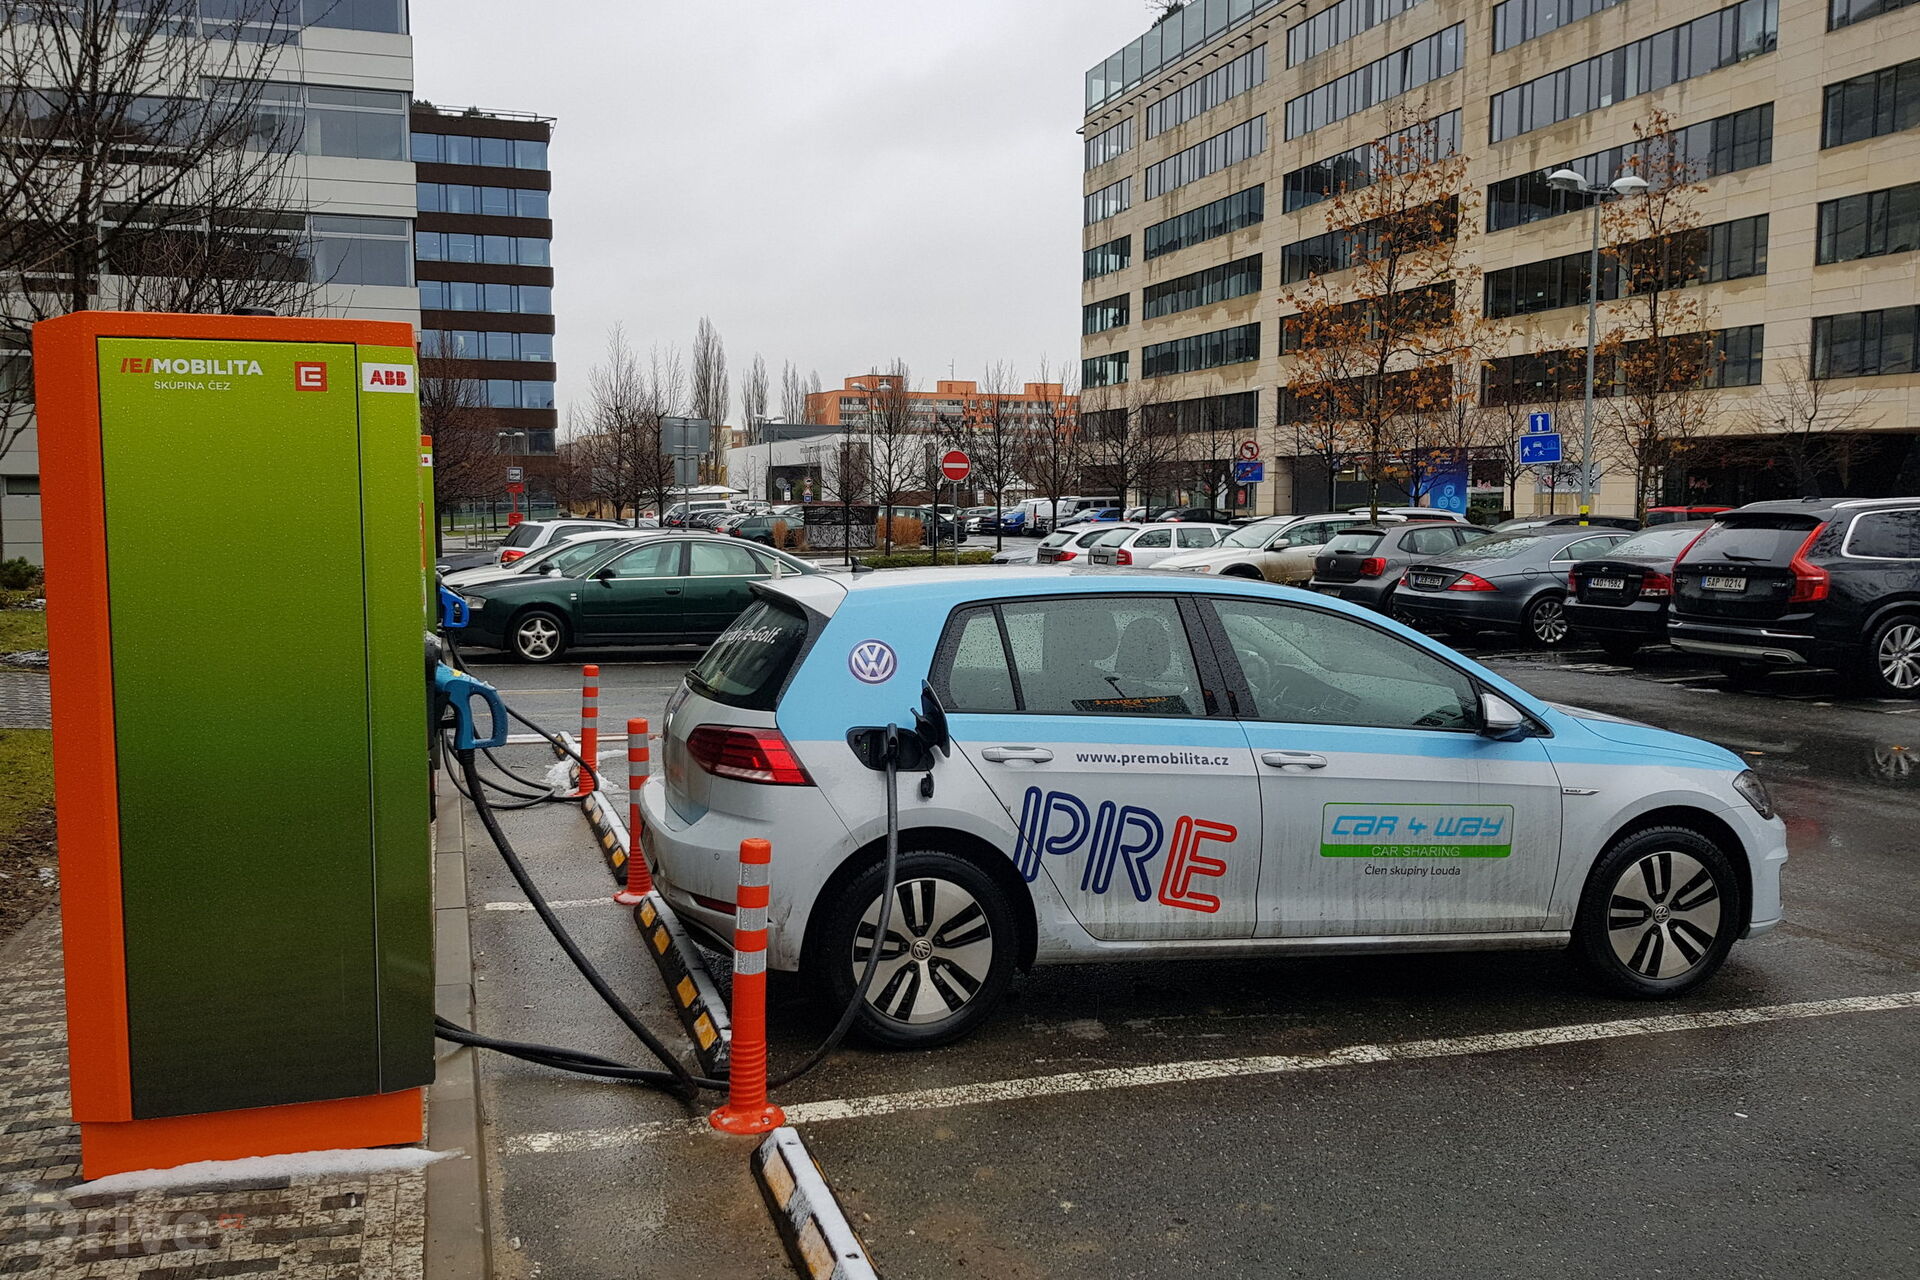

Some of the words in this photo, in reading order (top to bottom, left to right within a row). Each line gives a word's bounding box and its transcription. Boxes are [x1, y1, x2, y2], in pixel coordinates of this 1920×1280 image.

[154, 381, 204, 390] SKUPINA
[208, 379, 231, 390] ČEZ
[370, 370, 407, 386] ABB
[1706, 577, 1720, 587] 5AP
[1724, 578, 1743, 589] 0214
[1076, 752, 1229, 766] www.premobilita.cz
[1012, 786, 1237, 913] PRE
[1371, 847, 1398, 857] CAR
[1403, 847, 1460, 857] SHARING
[1364, 864, 1387, 875] Člen
[1390, 866, 1427, 877] skupiny
[1430, 866, 1461, 876] Louda
